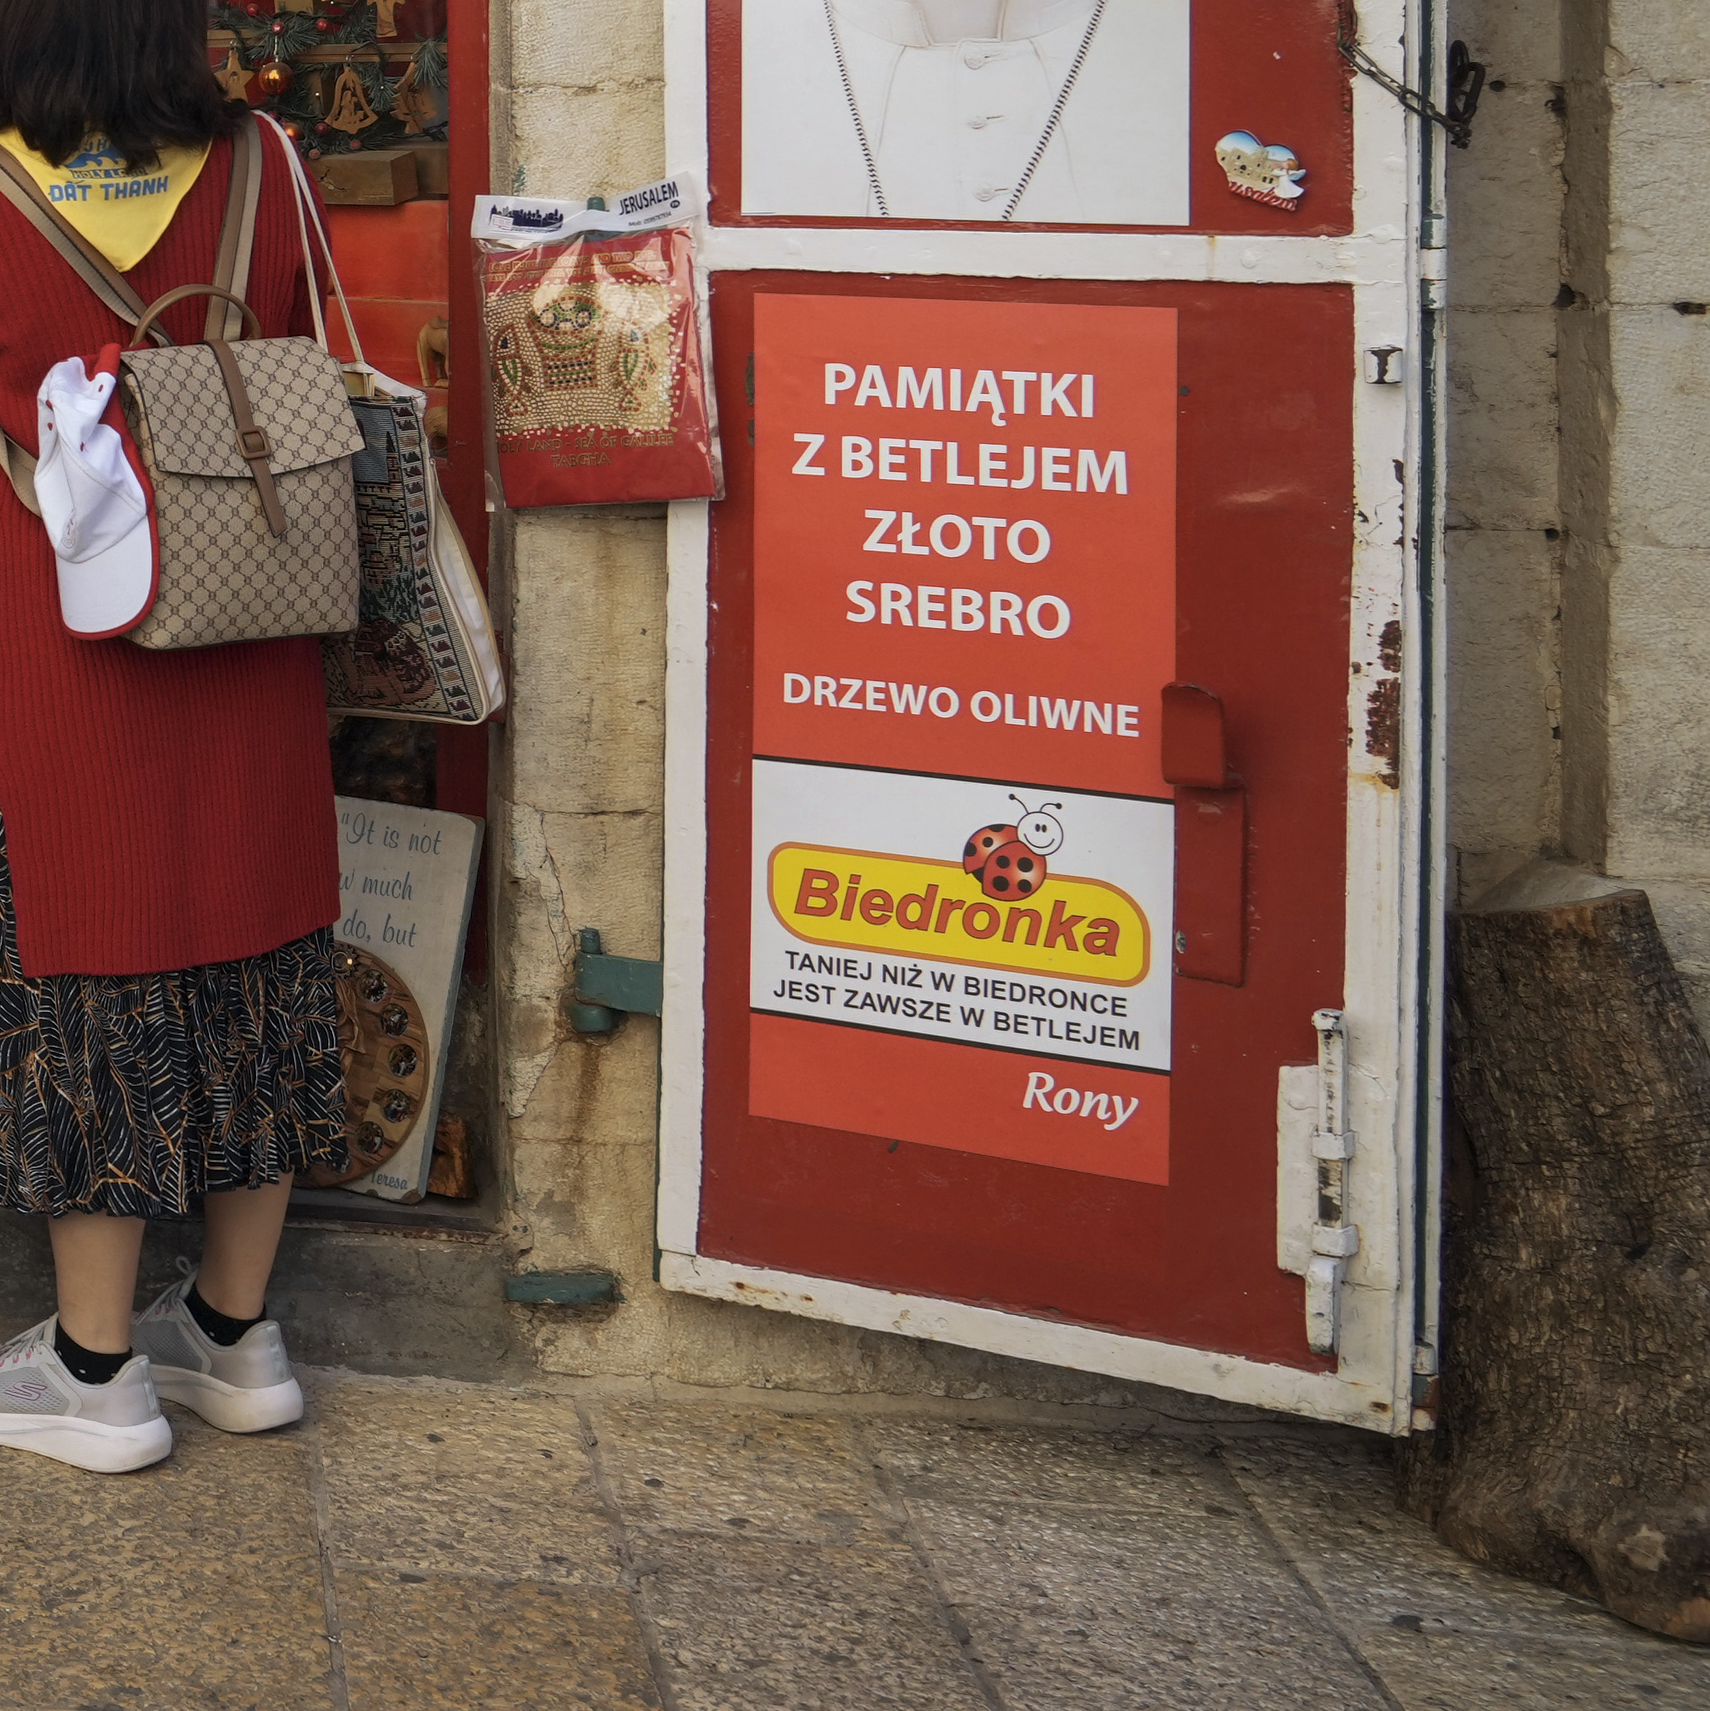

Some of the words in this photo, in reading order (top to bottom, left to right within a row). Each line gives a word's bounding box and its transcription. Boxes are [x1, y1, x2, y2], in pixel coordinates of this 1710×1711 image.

[73, 170, 107, 179] HOLY
[619, 181, 679, 216] JERUSALEM
[824, 363, 1095, 427] PAMIĄTKI
[527, 436, 563, 452] LAND
[574, 436, 598, 451] SEA
[600, 435, 618, 448] OF
[620, 432, 674, 447] GALILEE
[550, 454, 611, 467] TABGHA
[791, 433, 825, 476] Z
[841, 435, 1129, 495] BETLEJEM
[862, 509, 1051, 564] ZŁOTO
[845, 580, 1072, 640] SREBRO
[783, 672, 960, 719] DRZEWO
[970, 691, 1140, 738] OLIWNE
[382, 824, 399, 850] is
[409, 828, 443, 856] not
[362, 870, 414, 901] much
[793, 867, 1121, 956] Biedronka
[342, 909, 373, 944] do,
[382, 913, 418, 948] but
[785, 949, 873, 982] TANIEJ
[881, 964, 923, 988] NIŻ
[929, 970, 956, 992] W
[963, 976, 1128, 1018] BIEDRONCE
[773, 978, 837, 1006] JEST
[842, 989, 951, 1023] ZAWSZE
[958, 1007, 986, 1028] W
[993, 1011, 1141, 1051] BETLEJEM
[1022, 1071, 1139, 1131] Rony
